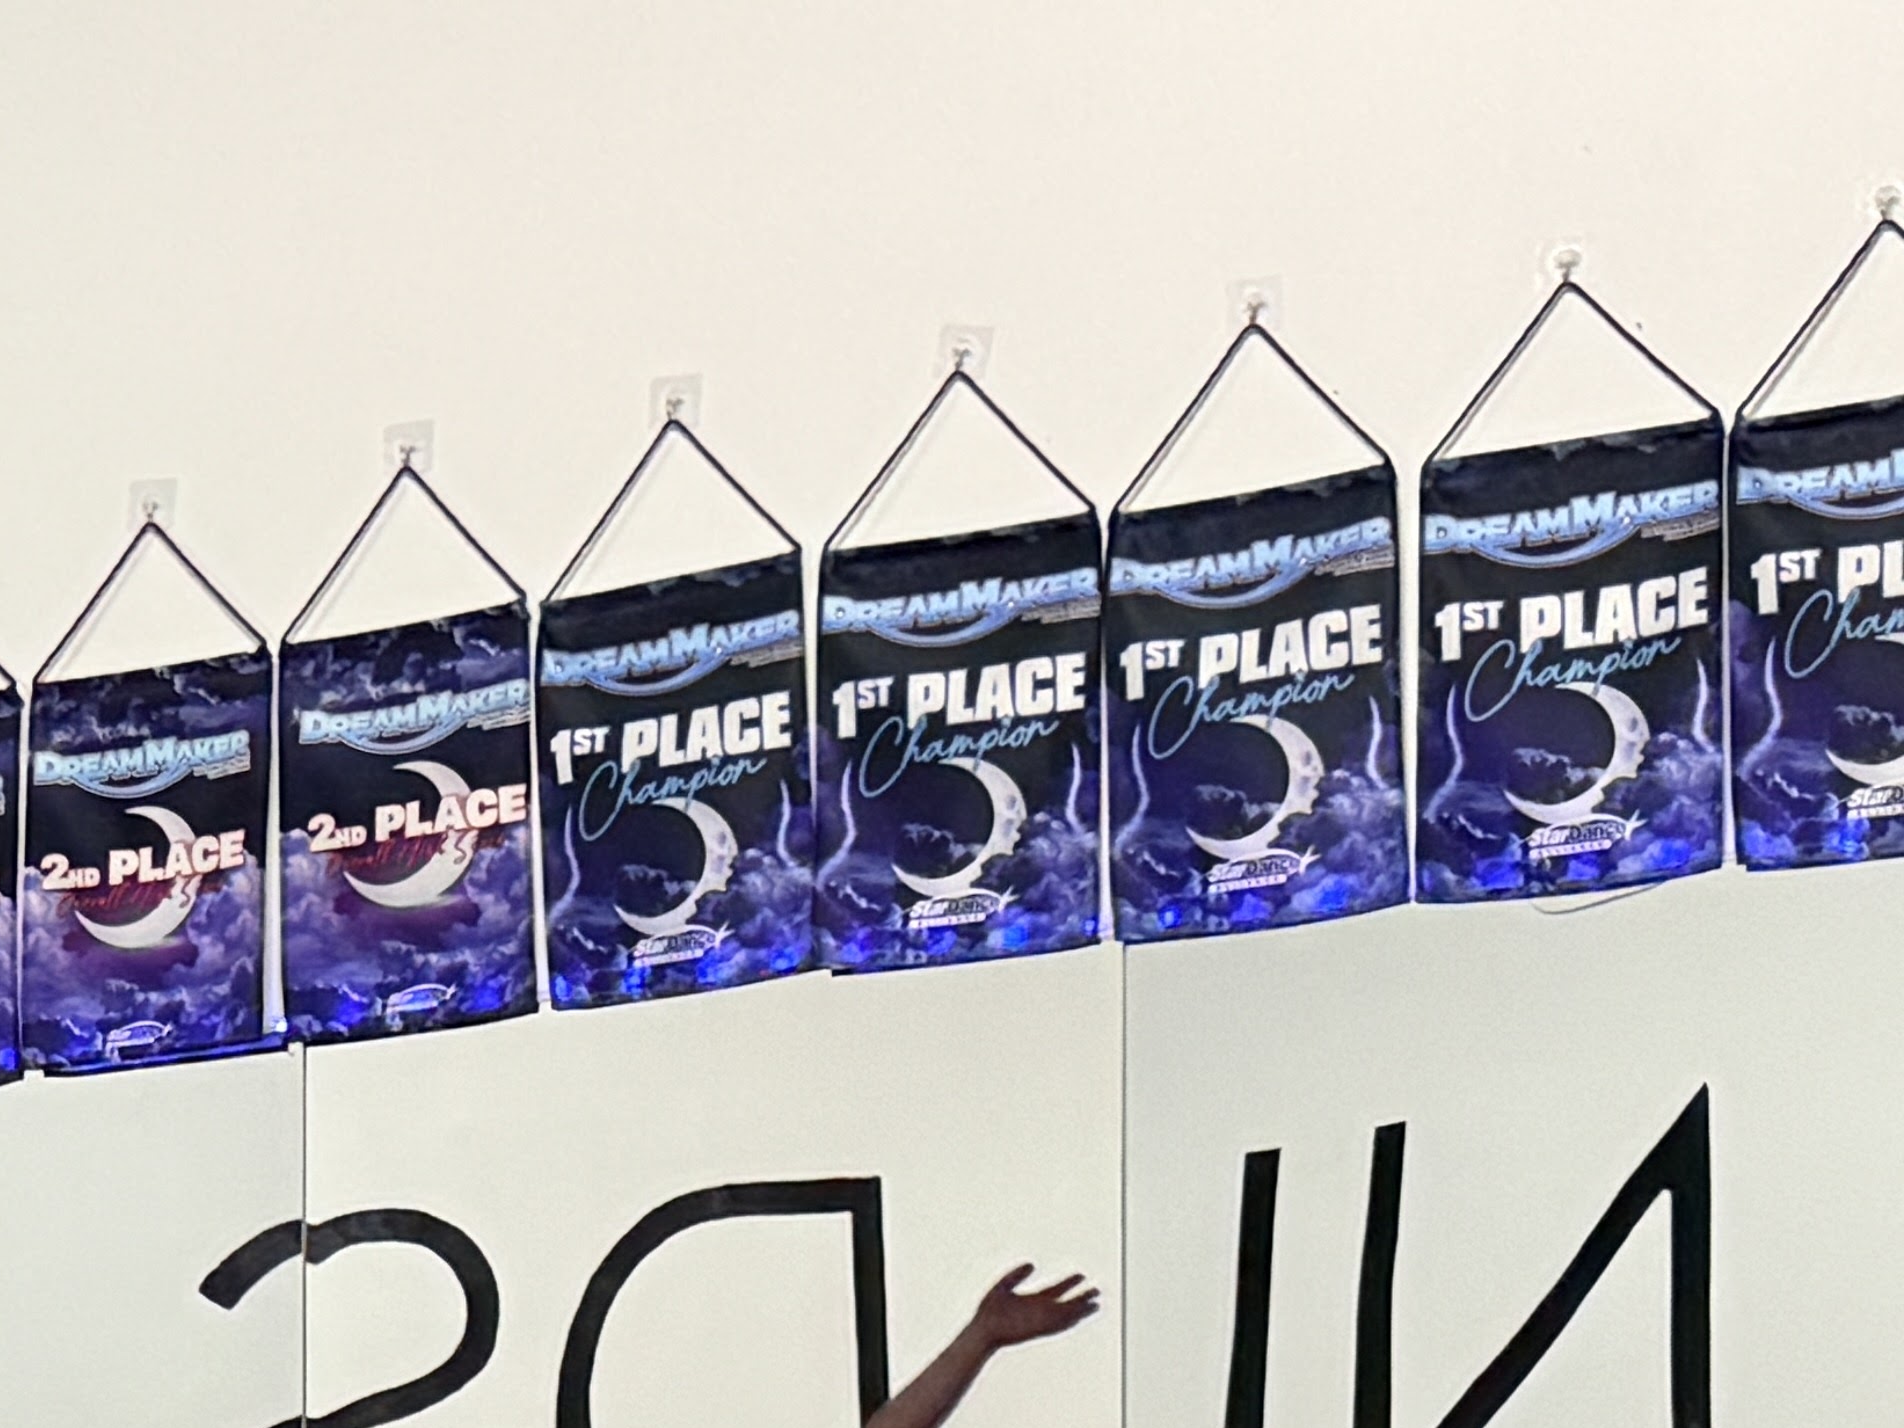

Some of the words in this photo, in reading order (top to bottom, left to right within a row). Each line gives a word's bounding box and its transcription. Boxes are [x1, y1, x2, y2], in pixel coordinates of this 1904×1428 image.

[1435, 600, 1504, 661] 1ST
[1519, 566, 1709, 653] PLACE
[1838, 540, 1904, 604] PL
[832, 676, 896, 739] 1ST
[906, 652, 1086, 730] PLACE
[1120, 638, 1186, 701] 1ST
[1198, 603, 1384, 690] PLACE
[1464, 633, 1681, 722] Champion
[550, 725, 610, 785] 1ST
[621, 690, 792, 773] PLACE
[858, 714, 1059, 798] Champion
[1148, 670, 1355, 761] Champion
[307, 813, 368, 855] 2ND
[374, 784, 529, 844] PLACE
[578, 754, 767, 841] Champion
[40, 853, 102, 891] 2ND
[107, 829, 247, 886] PLACE
